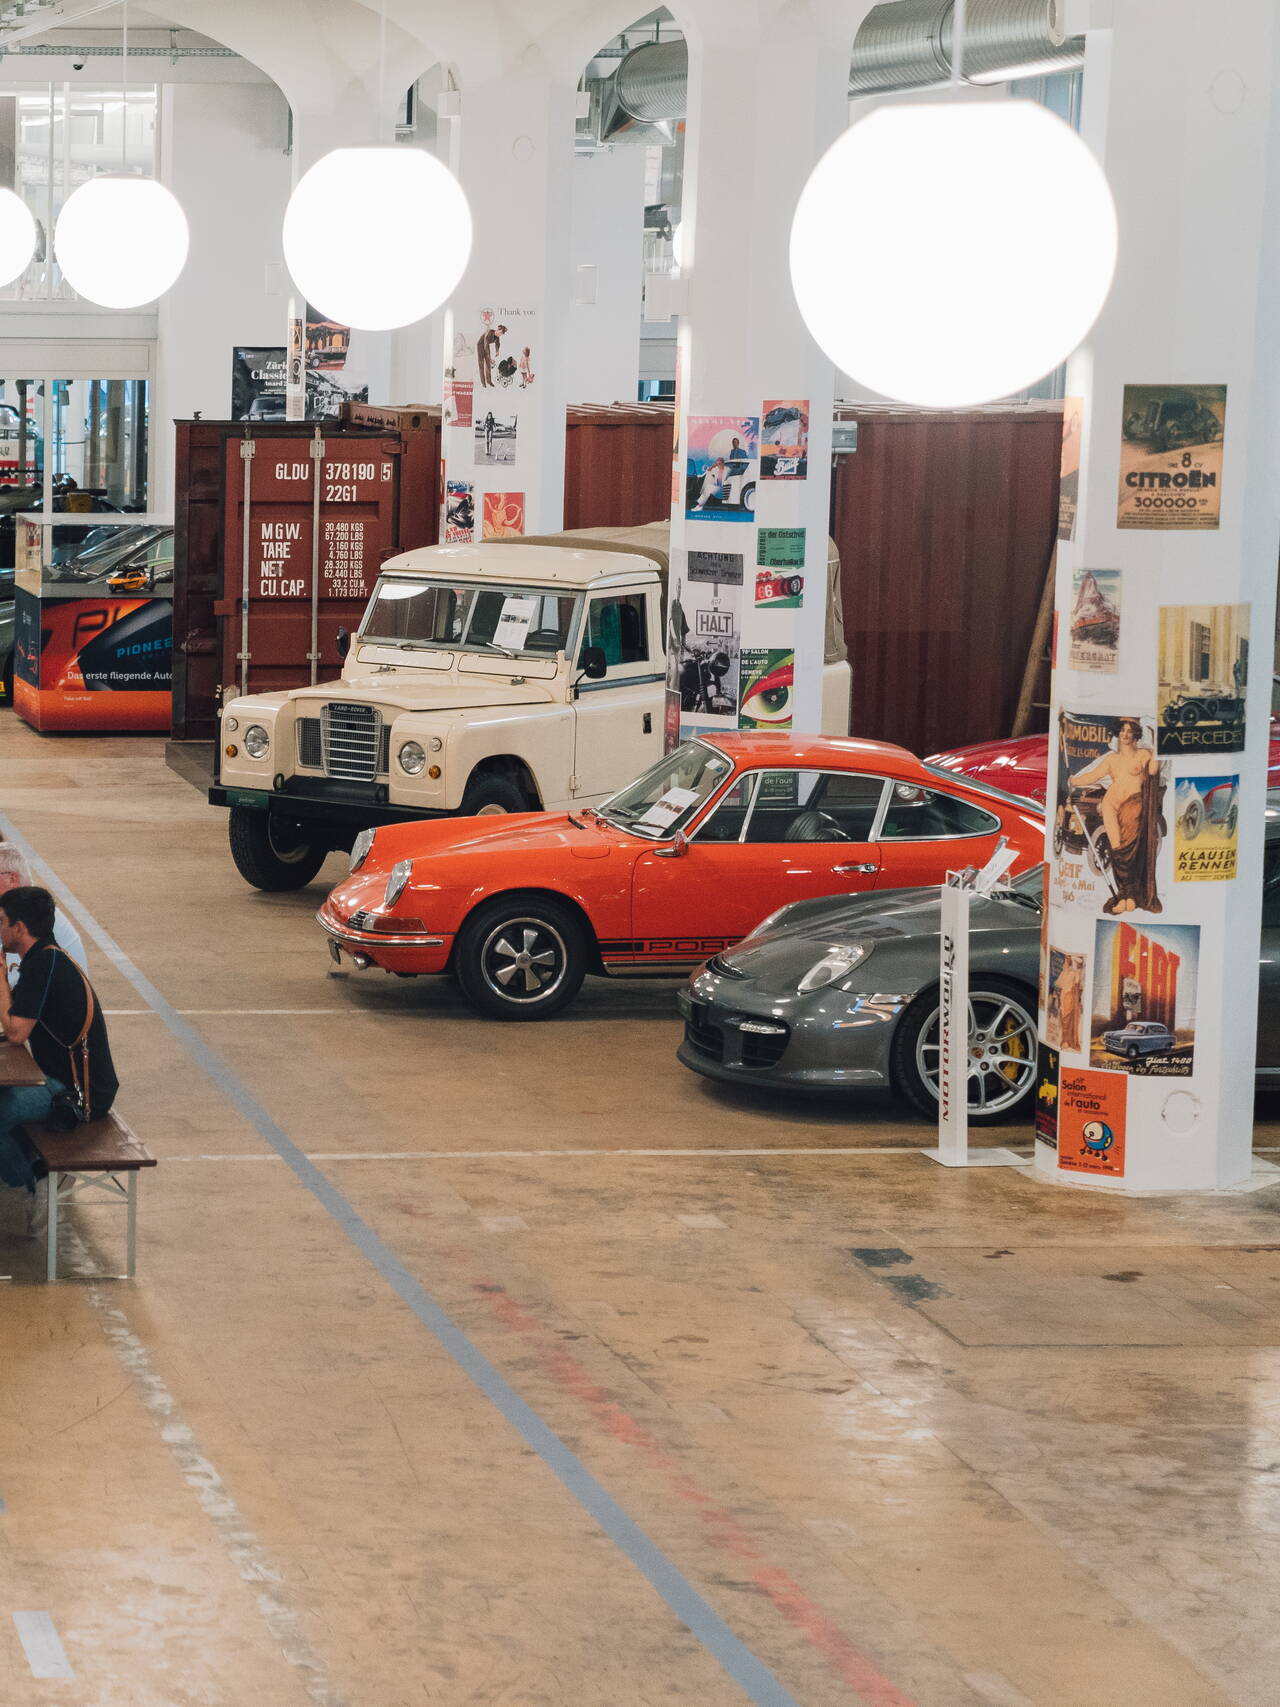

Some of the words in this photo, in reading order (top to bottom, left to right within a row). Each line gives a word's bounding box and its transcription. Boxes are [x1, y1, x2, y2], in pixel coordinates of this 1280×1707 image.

[498, 308, 520, 316] Thank
[1182, 452, 1192, 468] 8
[275, 463, 309, 480] GLDU
[325, 463, 375, 481] 378190
[382, 464, 392, 481] 5
[1125, 470, 1216, 488] CITROËN
[326, 485, 357, 501] 22G1
[1135, 497, 1197, 508] 300000
[325, 523, 349, 532] 30.480
[350, 523, 364, 532] KGS
[325, 532, 349, 541] 67.200
[350, 532, 364, 541] LBS
[261, 542, 291, 559] TARE
[329, 542, 349, 551] 2.160
[350, 542, 364, 551] KGS
[328, 551, 349, 559] 4.760
[350, 551, 363, 559] LBS
[697, 552, 735, 563] ACHTUNG
[261, 561, 284, 578] NET
[324, 561, 349, 569] 28.320
[350, 561, 363, 570] KGS
[324, 570, 348, 578] 62.440
[350, 570, 363, 578] LBS
[332, 579, 348, 588] 33.2
[328, 588, 348, 597] 1.173
[700, 614, 731, 633] HALT
[67, 672, 84, 680] Das
[110, 671, 152, 682] fliegende
[1179, 851, 1236, 861] KLAUSEN
[1178, 859, 1235, 870] RENNEN
[1062, 1080, 1087, 1091] Salon
[1071, 1097, 1100, 1110] l'auto
